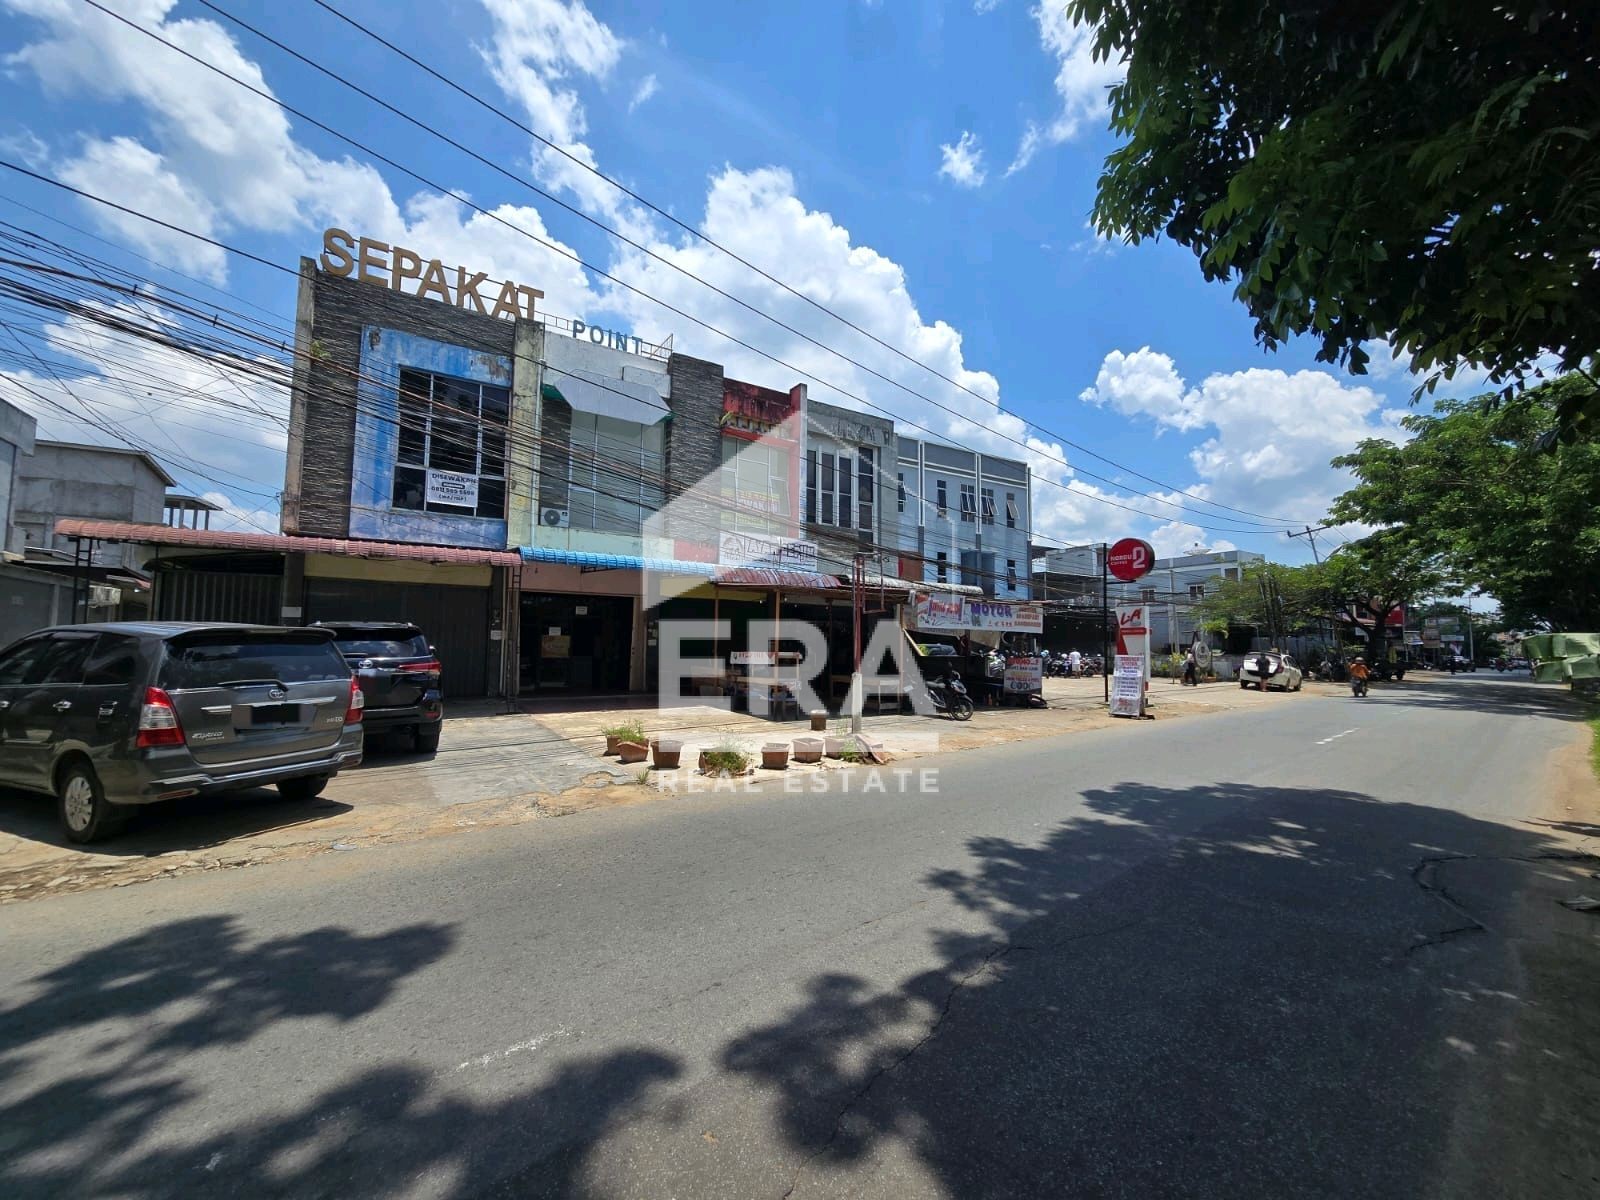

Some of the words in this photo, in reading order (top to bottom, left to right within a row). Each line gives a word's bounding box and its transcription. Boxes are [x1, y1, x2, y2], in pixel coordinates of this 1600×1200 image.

[320, 228, 545, 320] SEPAKAT
[572, 320, 643, 356] POINT
[1132, 546, 1146, 569] 2
[970, 602, 1013, 618] MOTOR
